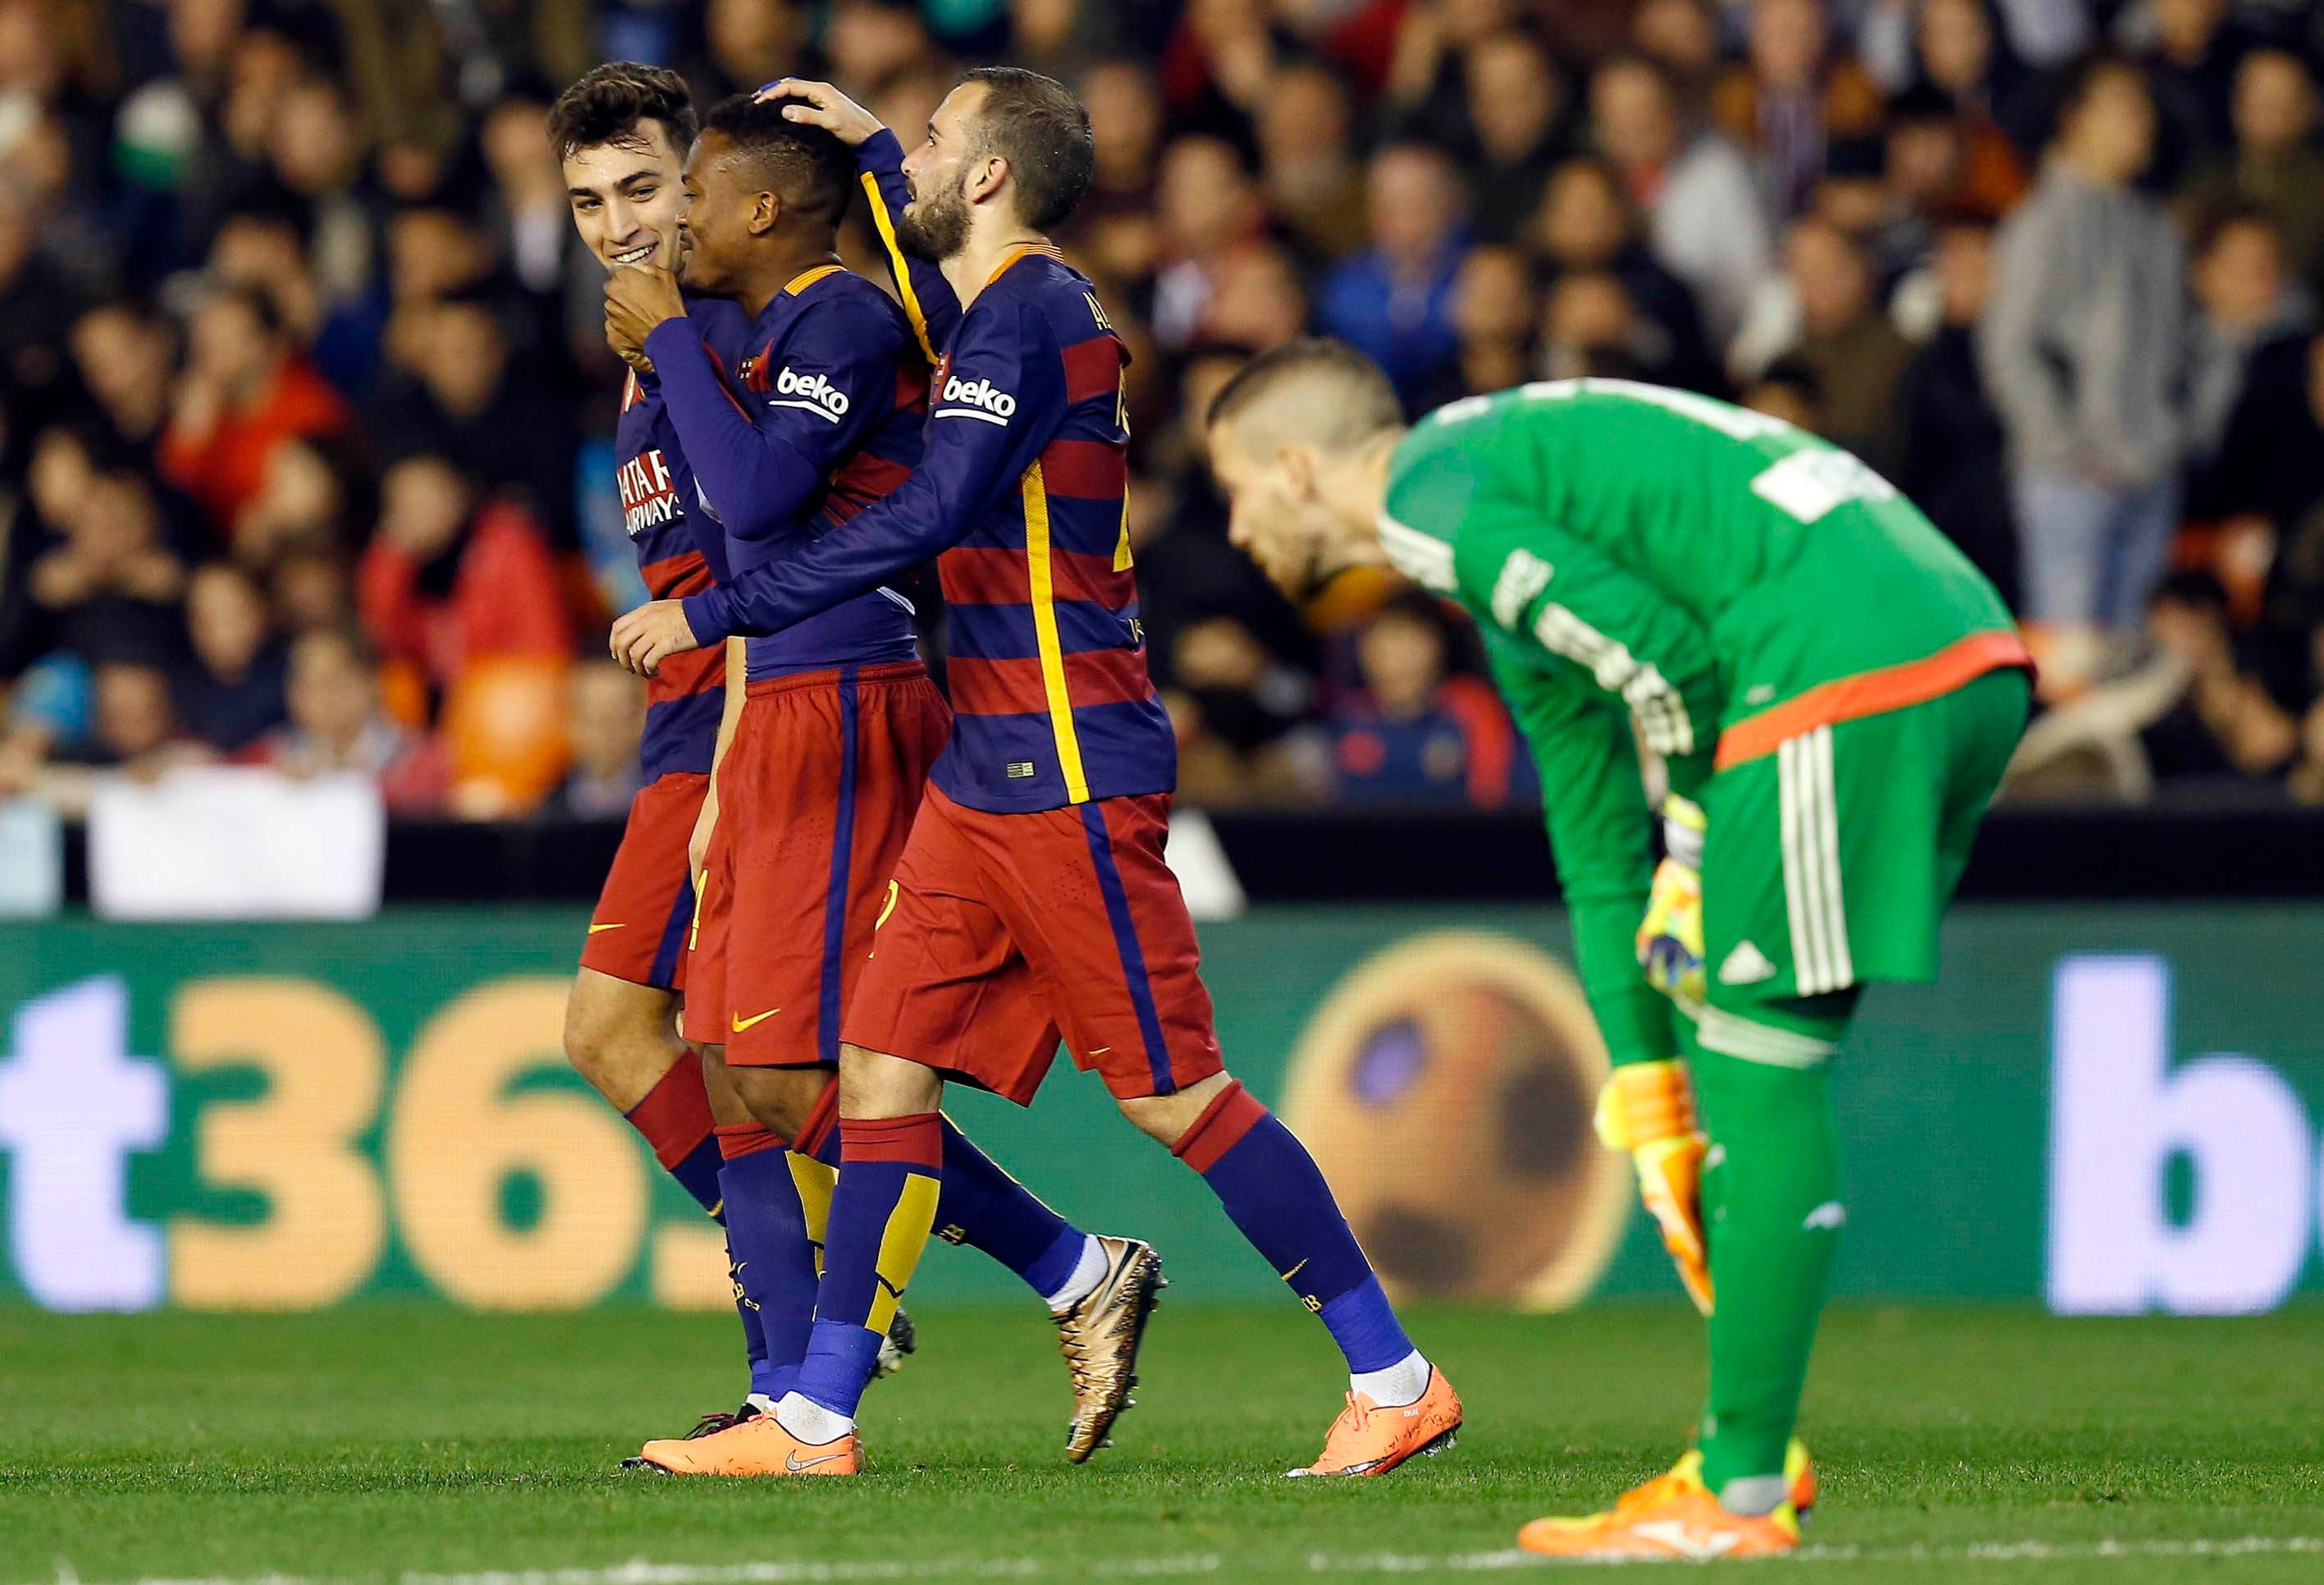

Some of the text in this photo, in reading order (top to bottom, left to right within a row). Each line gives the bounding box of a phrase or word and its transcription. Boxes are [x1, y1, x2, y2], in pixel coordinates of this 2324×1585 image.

[777, 366, 849, 415] beko
[943, 375, 1016, 417] beko
[0, 973, 739, 1313] t36
[2045, 952, 2324, 1315] b
